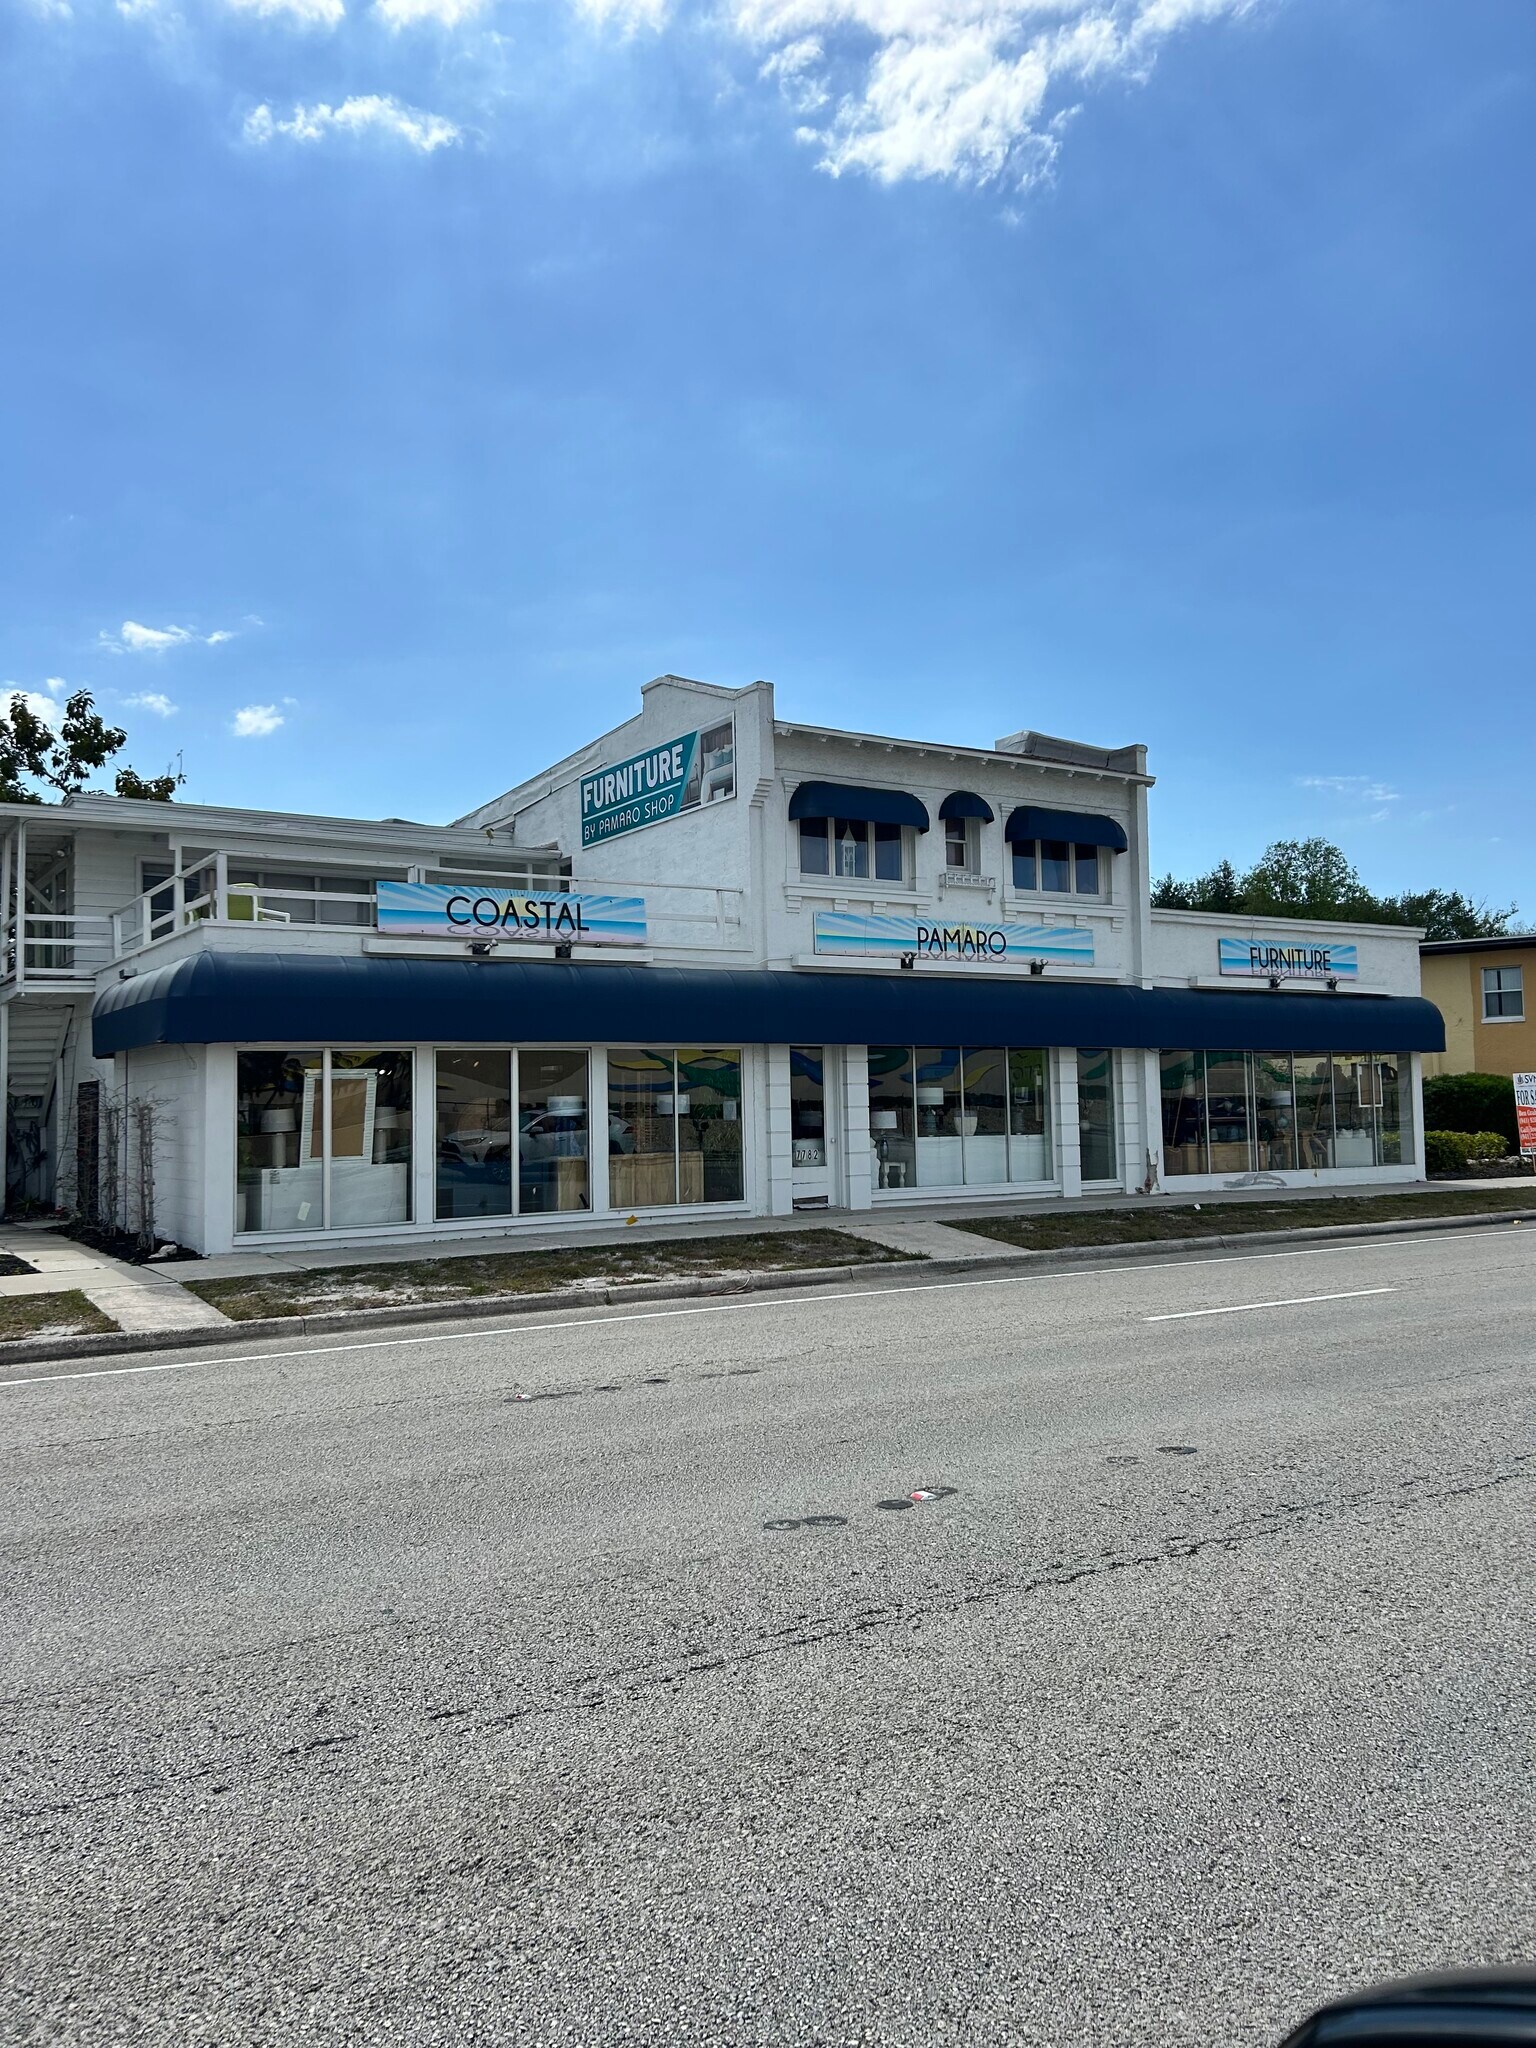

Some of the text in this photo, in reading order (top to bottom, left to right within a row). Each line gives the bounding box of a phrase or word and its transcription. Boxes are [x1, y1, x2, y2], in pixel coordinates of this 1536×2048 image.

[583, 743, 684, 813] FURNITURE
[584, 794, 675, 840] BY PAMARO SHOP
[446, 896, 590, 932] COASTAL
[917, 926, 1007, 955] PAMARO
[1250, 947, 1331, 971] FURNITURE
[1516, 1090, 1530, 1106] FOR
[796, 1149, 818, 1160] 7782
